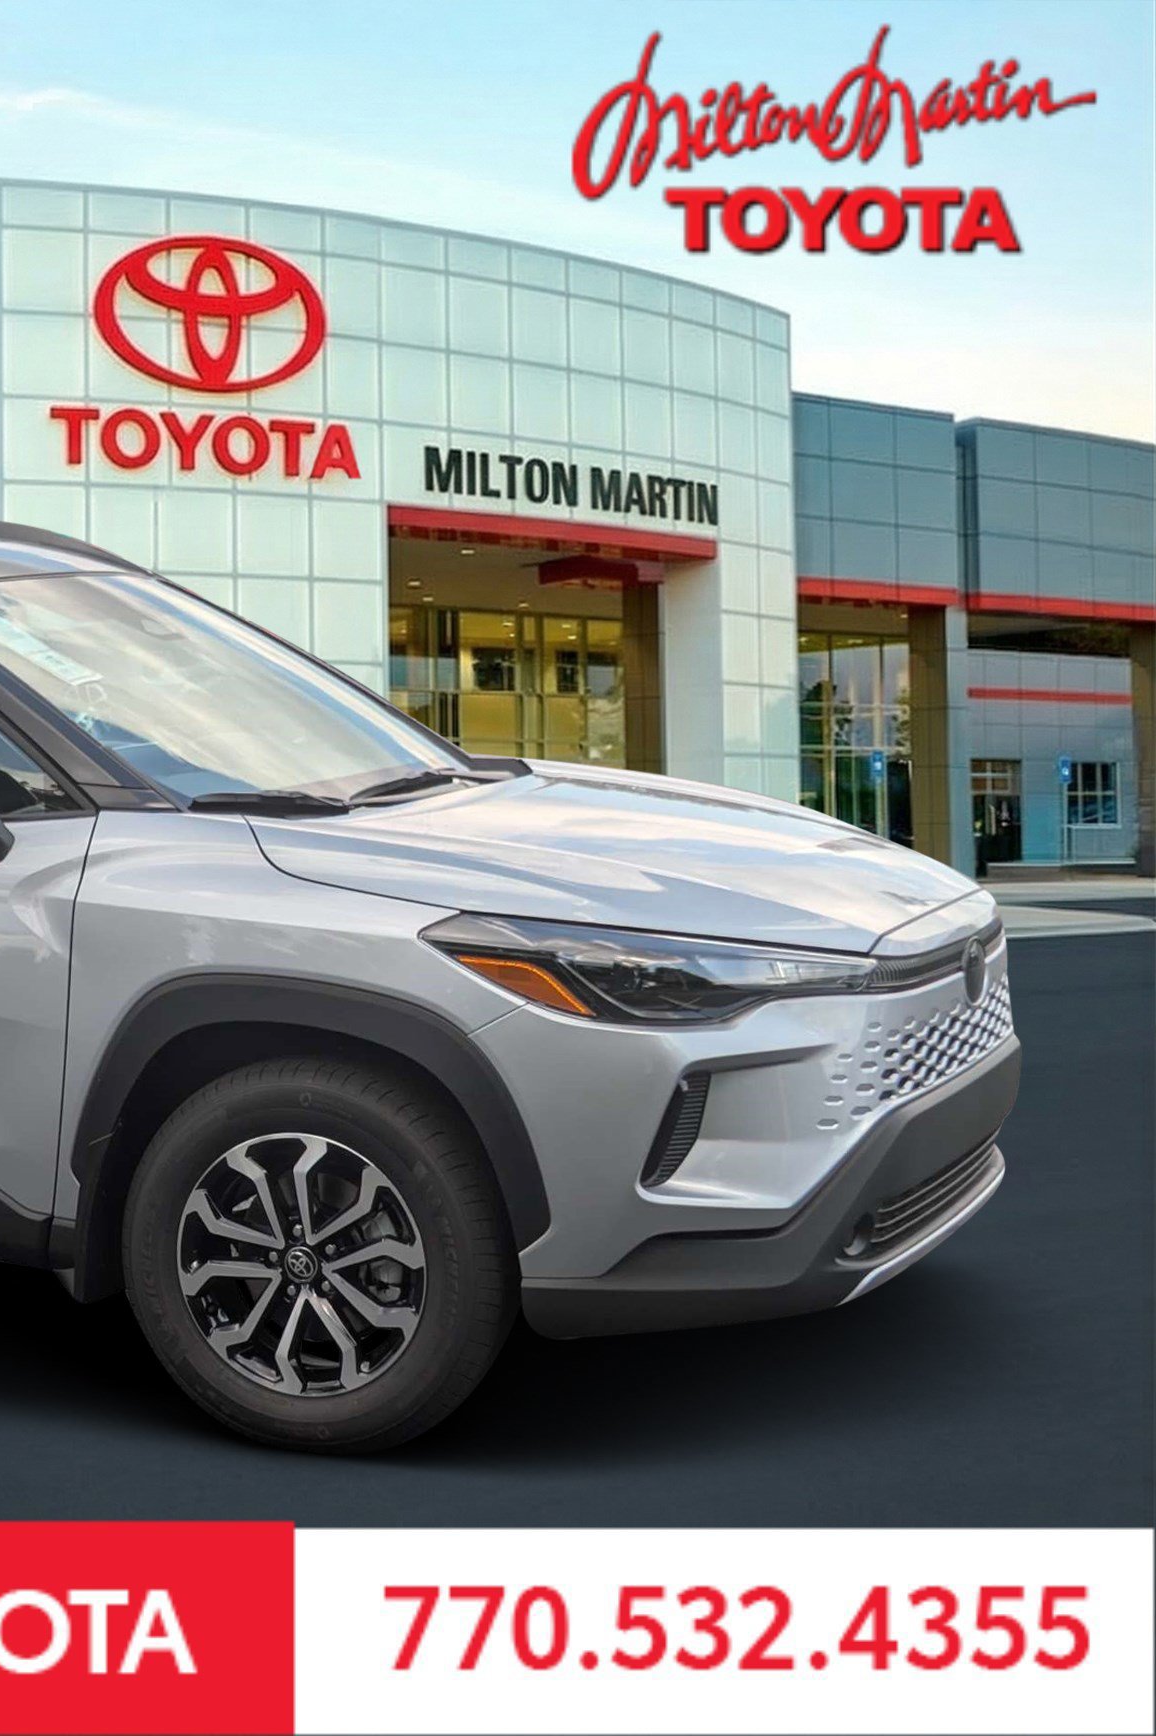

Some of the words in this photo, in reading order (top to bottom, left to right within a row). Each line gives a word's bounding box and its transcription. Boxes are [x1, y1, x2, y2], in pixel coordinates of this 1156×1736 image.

[50, 407, 361, 479] TOYOTA
[424, 446, 579, 508] MILTON
[590, 467, 719, 526] MARTIN
